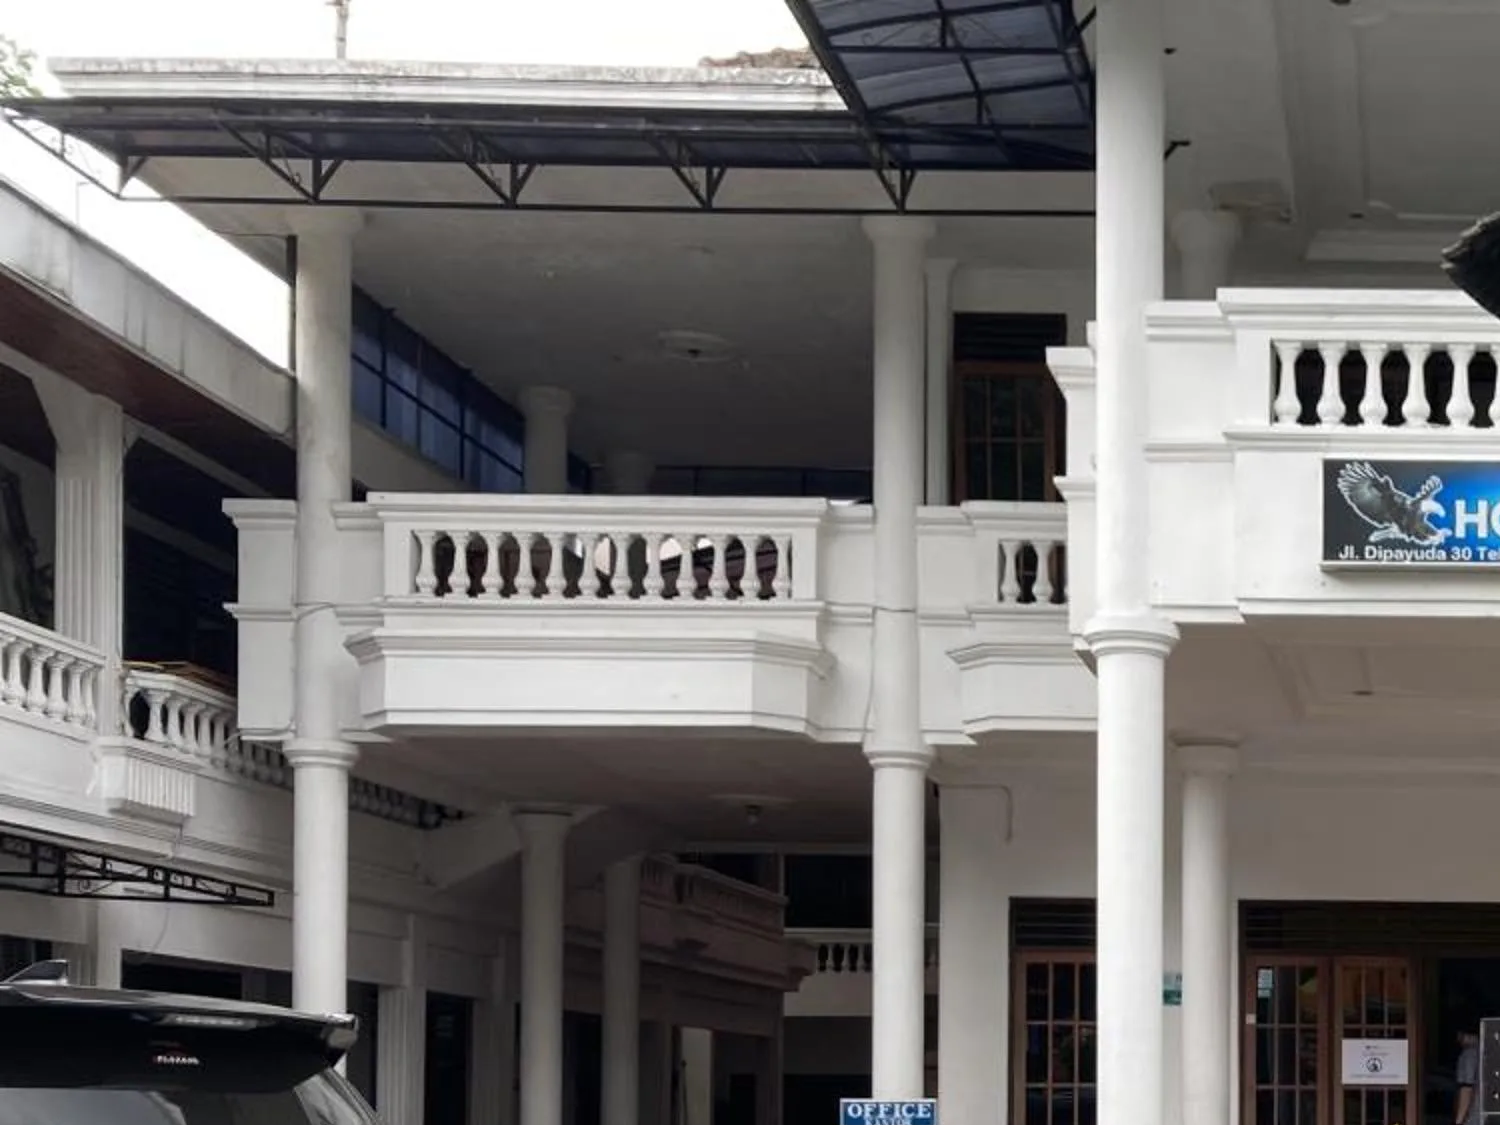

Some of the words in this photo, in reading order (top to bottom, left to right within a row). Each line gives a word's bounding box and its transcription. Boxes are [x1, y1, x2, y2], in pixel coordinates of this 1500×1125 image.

[1338, 545, 1359, 560] Jl.
[1364, 545, 1448, 563] Dipayuda
[1452, 546, 1472, 561] 30
[847, 1103, 931, 1119] OFFICE
